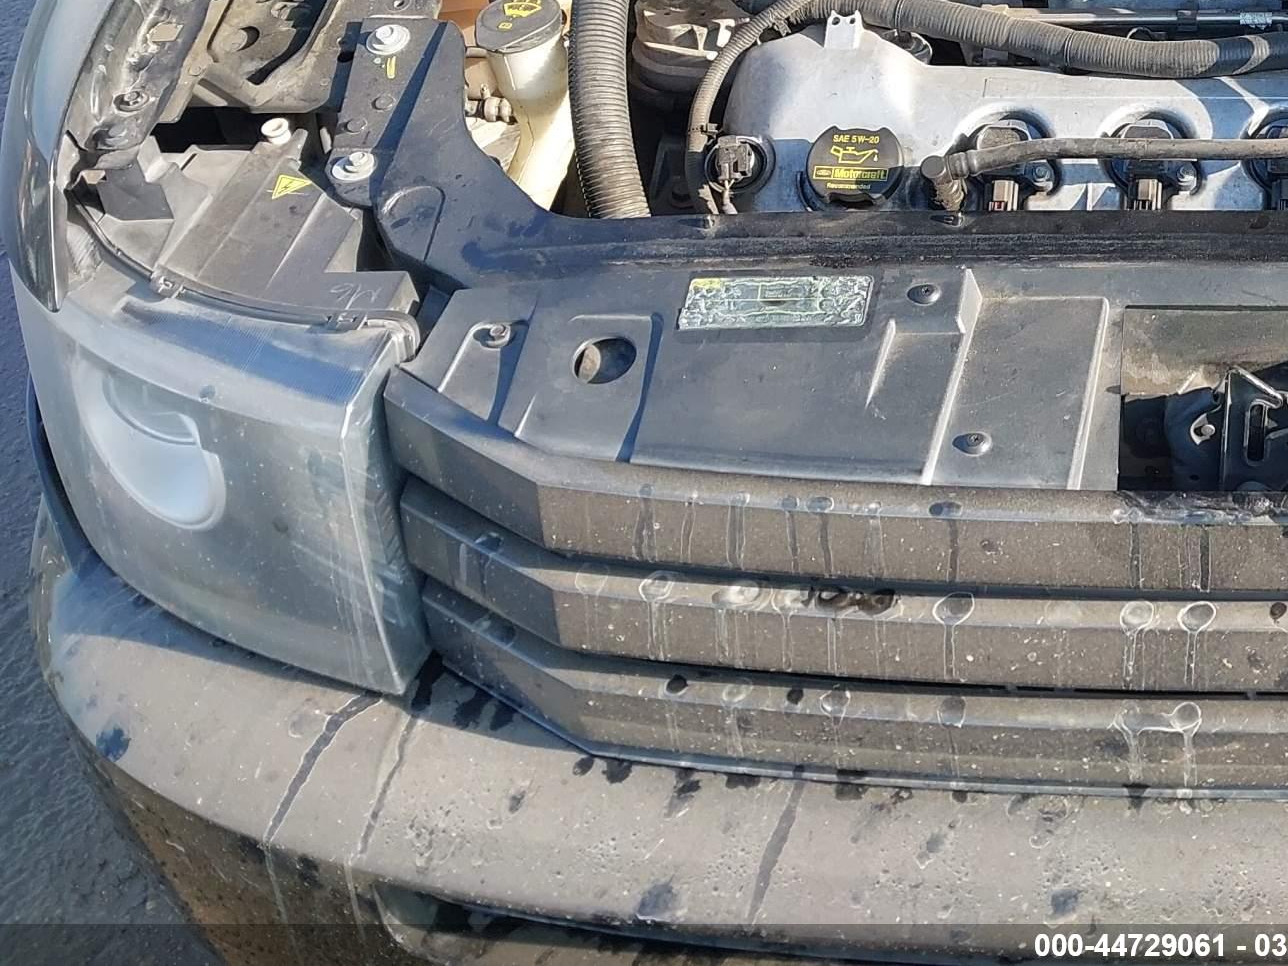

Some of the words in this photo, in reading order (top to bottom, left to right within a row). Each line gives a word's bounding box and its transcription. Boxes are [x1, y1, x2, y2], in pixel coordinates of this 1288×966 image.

[833, 135, 850, 143] SAE
[851, 135, 880, 144] 5W-20
[834, 168, 885, 179] Motorcraft
